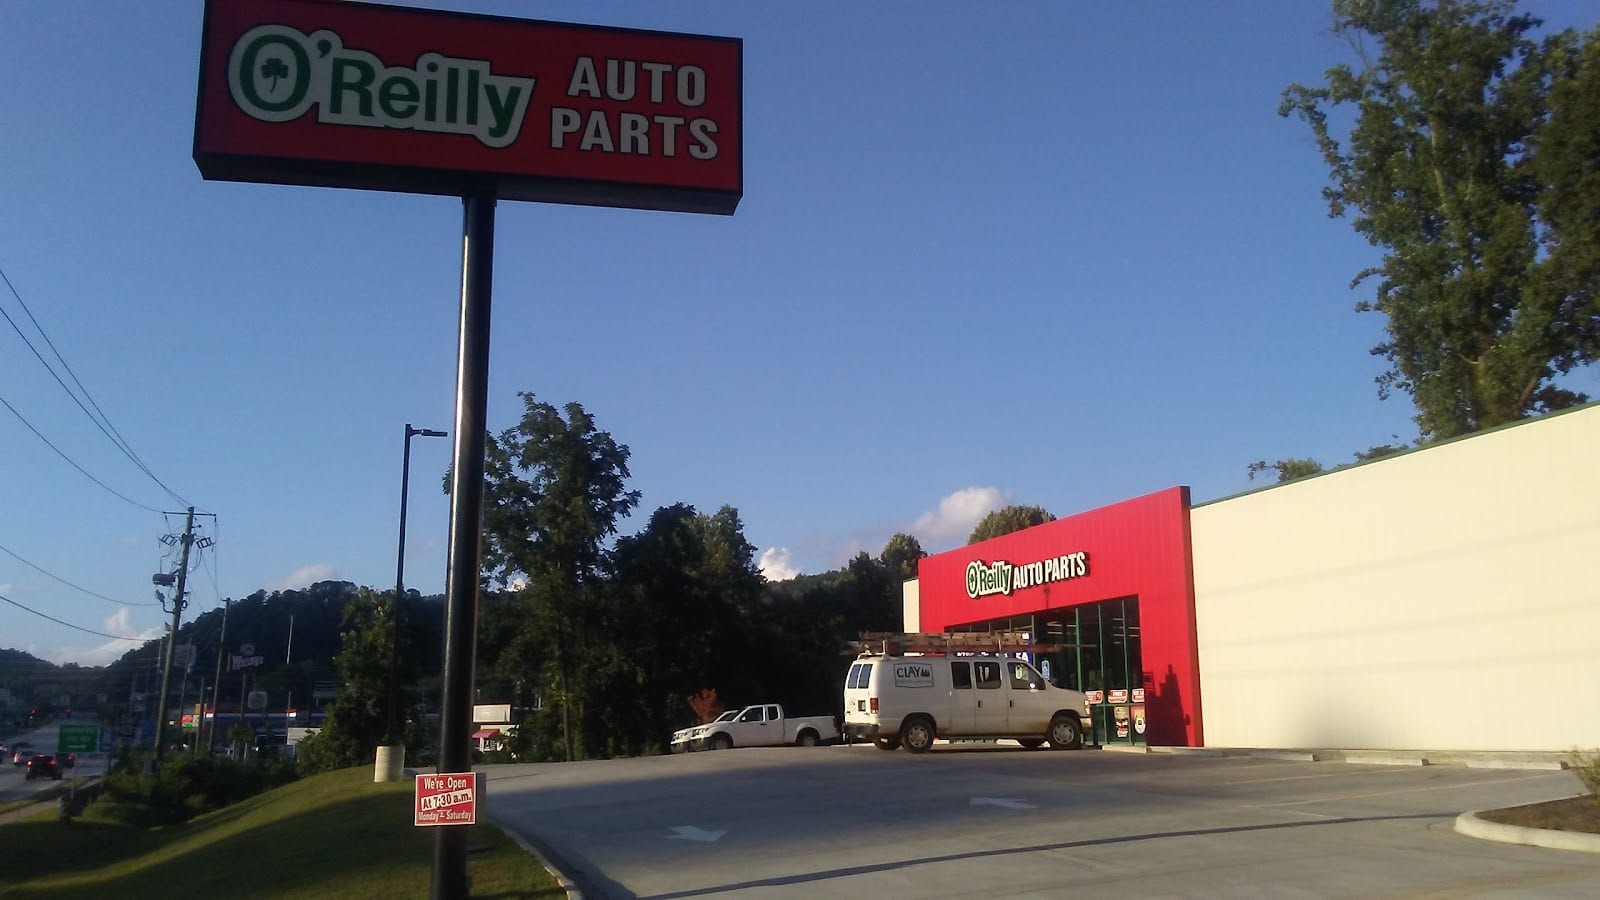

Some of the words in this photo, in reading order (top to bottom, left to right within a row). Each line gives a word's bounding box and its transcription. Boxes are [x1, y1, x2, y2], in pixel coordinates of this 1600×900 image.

[229, 25, 534, 147] O'Reilly
[567, 57, 706, 107] AUTO
[551, 107, 719, 161] PARTS
[966, 560, 1012, 598] O'Reilly
[1013, 561, 1044, 590] AUTO
[1044, 551, 1086, 582] PARTS
[896, 665, 920, 678] CLAY
[424, 777, 444, 789] We're
[447, 776, 467, 791] Open
[418, 812, 440, 823] Monday
[446, 810, 472, 821] Saturday
[422, 799, 432, 810] At
[433, 793, 452, 807] 7:30
